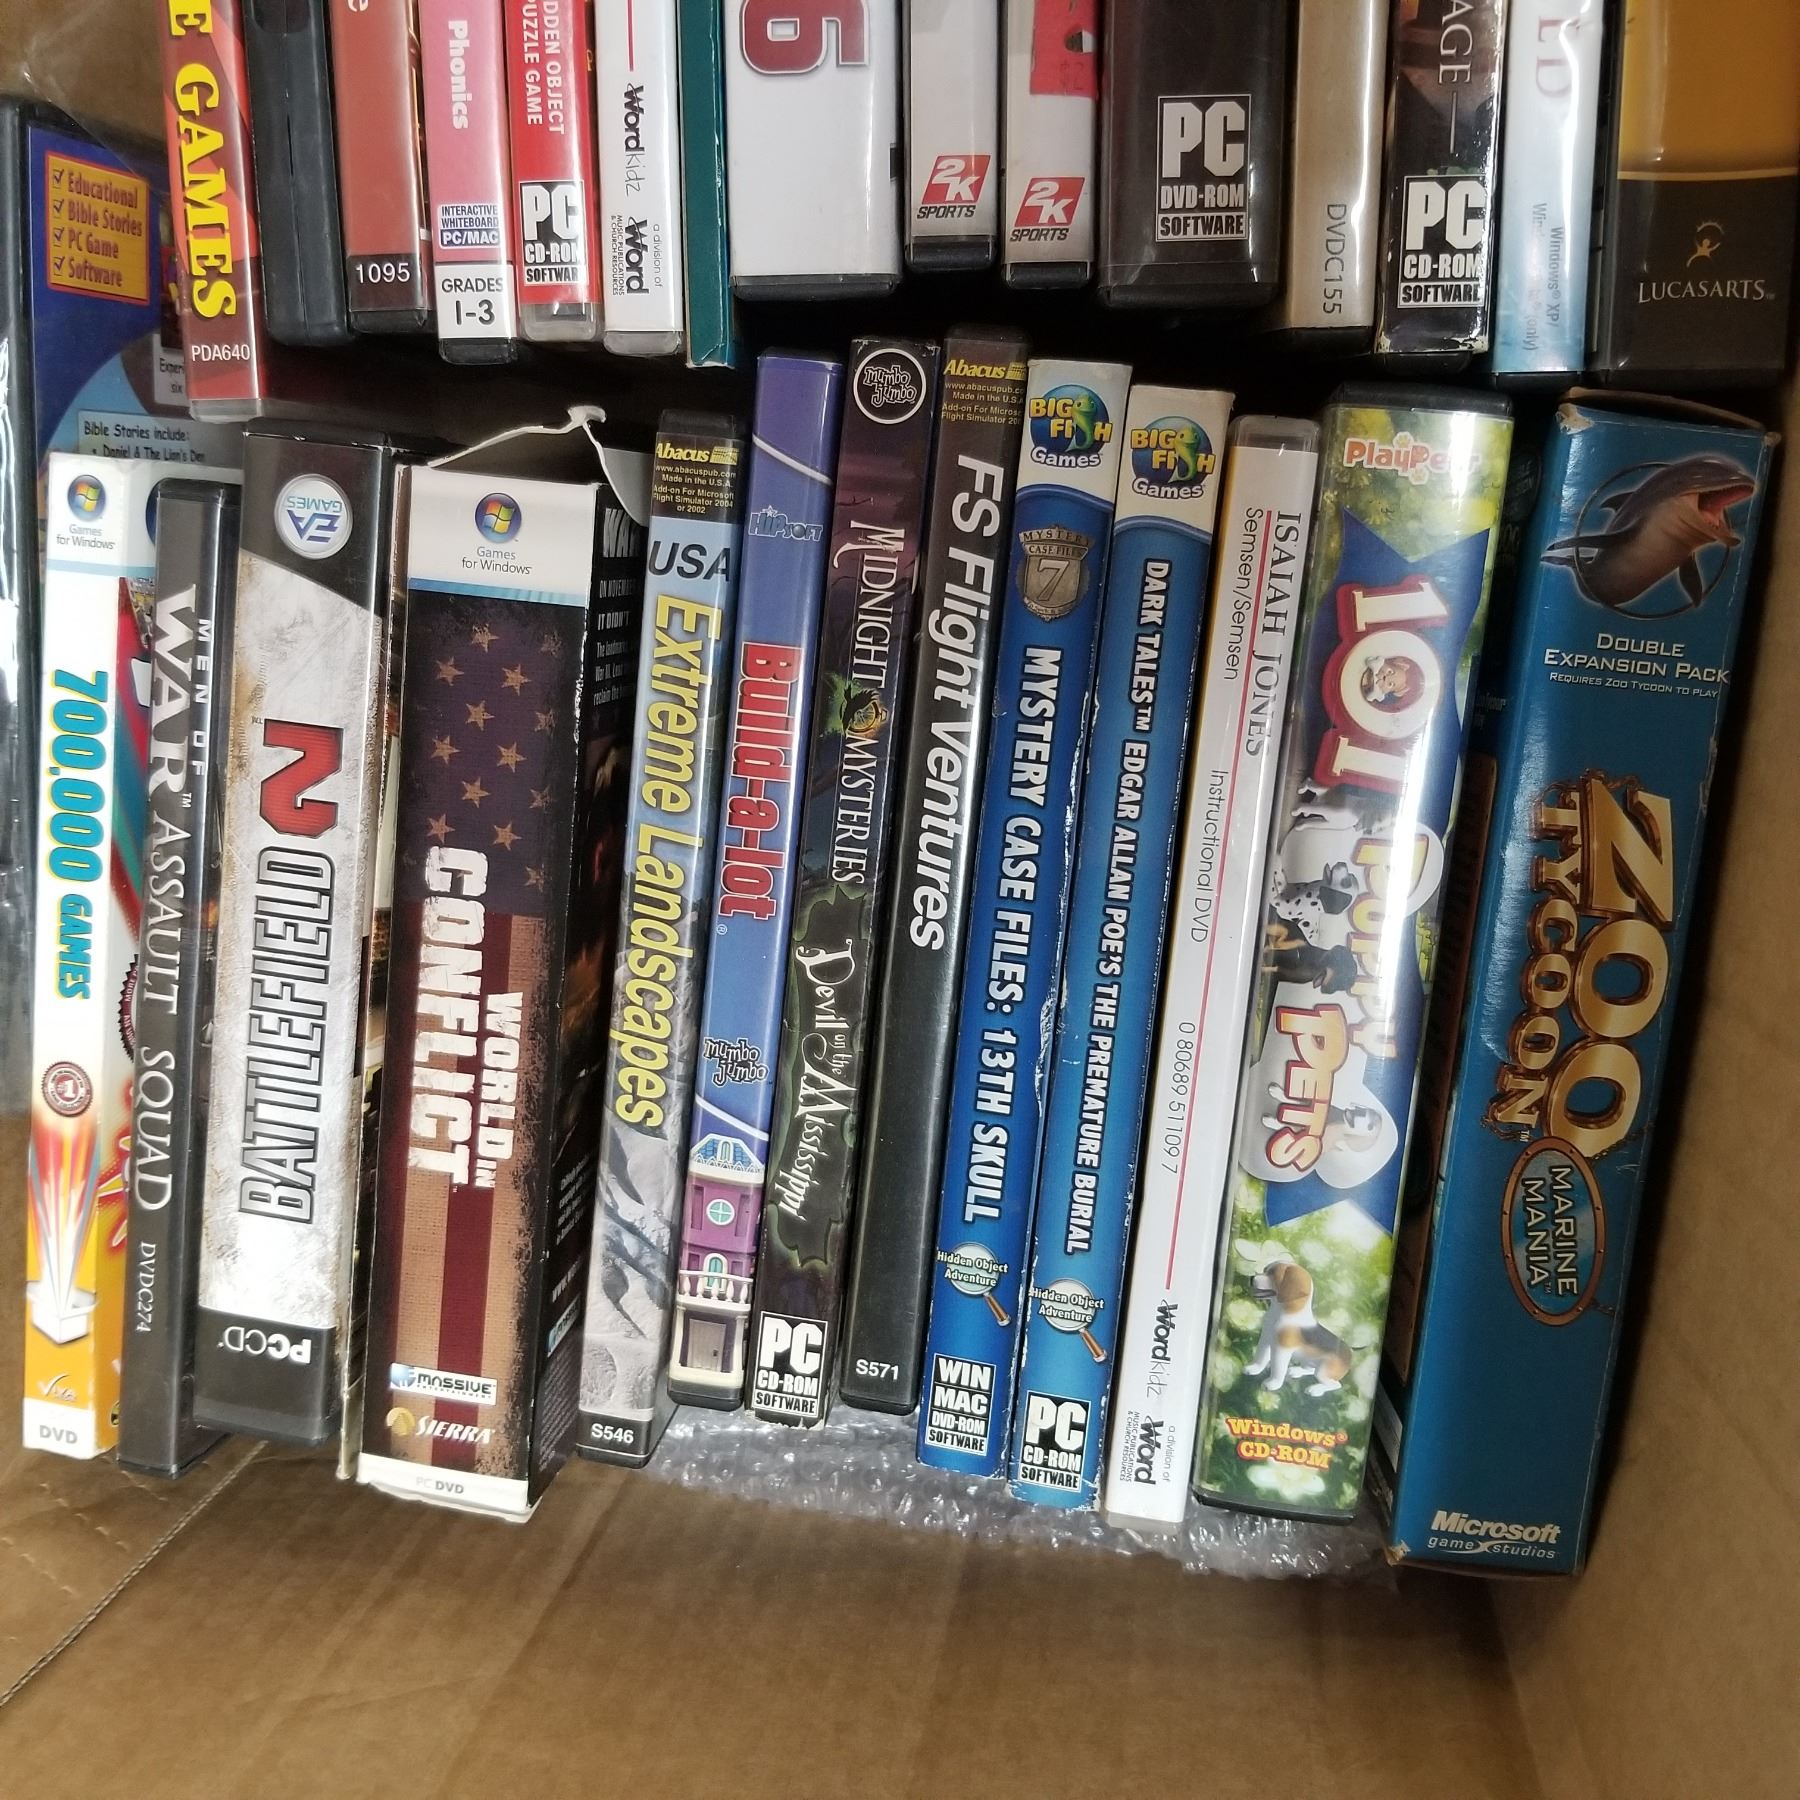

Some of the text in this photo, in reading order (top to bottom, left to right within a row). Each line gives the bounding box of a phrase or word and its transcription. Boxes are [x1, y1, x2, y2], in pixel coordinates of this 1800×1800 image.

[448, 20, 473, 130] Phonics
[525, 70, 543, 125] GAME
[546, 61, 565, 135] OBJECT
[624, 82, 647, 197] Wordkidz
[1162, 101, 1245, 178] PC
[68, 170, 138, 209] Educational
[173, 63, 237, 319] GAMES
[932, 159, 980, 201] 2K
[441, 204, 498, 216] INTERACTIVE
[1025, 182, 1074, 224] 2K
[1160, 184, 1244, 210] DVD-ROM
[68, 200, 142, 237] Bible Stories
[441, 217, 499, 229] WHITEBOARD
[521, 185, 578, 241] PC
[916, 205, 977, 220] SPORTS
[1160, 214, 1244, 236] SOFTWARE
[1405, 181, 1486, 250] PC
[68, 227, 118, 259] PC Game
[442, 231, 499, 245] PC/MAC
[1009, 228, 1069, 242] SPORTS
[617, 242, 625, 296] PUBLICATIONS
[624, 216, 650, 294] Word
[653, 235, 662, 274] division
[1322, 203, 1347, 315] DVDC155
[1403, 253, 1481, 279] CD-ROM
[68, 256, 122, 287] Software
[355, 262, 411, 284] 1095
[441, 278, 503, 293] GRADES
[1638, 279, 1766, 304] LUCASARTS
[191, 344, 251, 362] PDA640
[863, 366, 911, 387] mumbo
[943, 359, 1006, 379] Abacus
[871, 384, 917, 406] jumbo
[942, 402, 972, 412] Add-on
[952, 391, 975, 400] Made
[1030, 397, 1073, 419] BIG
[84, 421, 150, 439] Bible Stories
[941, 411, 1006, 424] Flight Simulator
[103, 444, 160, 460] Daniel The
[656, 443, 710, 462] Abacus
[1131, 429, 1177, 450] BIG
[1031, 447, 1101, 468] Games
[662, 474, 682, 483] Made
[1132, 477, 1203, 500] Games
[287, 496, 342, 513] GAMES
[675, 495, 713, 506] Simulator
[683, 488, 734, 500] For Microsoft
[687, 506, 706, 514] 2002
[69, 523, 103, 537] Games
[287, 509, 341, 543] EA
[56, 534, 115, 551] for Windows
[476, 545, 516, 560] Games
[1029, 545, 1054, 554] CASE
[461, 557, 532, 575] for Windows
[648, 540, 731, 582] USA
[1037, 559, 1070, 601] 7
[1223, 507, 1264, 681] Semsen/Semsen
[1244, 511, 1301, 757] ISAIAH JONES
[191, 619, 212, 776] MEN OF
[831, 520, 905, 884] MIDNIGHT MYSTERIES
[909, 454, 1004, 951] FS Flight Ventures
[1010, 648, 1062, 806] MYSTERY
[718, 643, 806, 920] Build-a-lot
[47, 669, 108, 1000] 700,000 GAMES
[609, 594, 723, 1127] Extreme Landscapes
[1000, 816, 1041, 901] CASE
[1066, 560, 1172, 1255] DARK EDGAR ALLAN POE'S THE PREMATURE BURIAL
[238, 718, 344, 1225] BATTLEFIELD 2
[984, 910, 1032, 1014] FILES:
[1161, 769, 1229, 1174] Instructional DVD 80689 51109 7
[1495, 789, 1582, 1131] TYCOON
[1548, 777, 1676, 1158] ZOO
[795, 938, 855, 1029] Devil
[408, 845, 489, 1186] CONFLICT
[703, 1038, 760, 1062] mumbo
[134, 811, 191, 1333] ASSAULT SQUAD DVDC274
[713, 1060, 769, 1085] jumbo
[979, 1030, 1016, 1113] 13TH
[474, 991, 524, 1188] WORLD IN
[1264, 1003, 1350, 1173] PETS
[774, 1032, 858, 1222] Mississippi
[965, 1122, 1008, 1223] SKULL
[1520, 1177, 1550, 1286] MANIA
[1551, 1164, 1578, 1296] MARINE
[937, 1250, 1009, 1273] Hidden Object
[944, 1268, 997, 1287] Adventure
[1031, 1287, 1105, 1309] Hidden Object
[1038, 1304, 1093, 1323] Adventure
[760, 1316, 822, 1375] PC
[1144, 1298, 1179, 1400] Wordkidz
[417, 1373, 492, 1395] MASSIVE
[757, 1369, 819, 1397] CD-ROM
[855, 1358, 900, 1381] S571
[938, 1357, 992, 1390] WIN
[755, 1391, 815, 1414] SOFTWARE
[934, 1386, 988, 1416] MAC
[39, 1425, 78, 1444] DVD
[416, 1415, 493, 1444] SIERRA
[591, 1422, 634, 1444] S546
[932, 1411, 986, 1436] DVD-ROM
[1026, 1394, 1087, 1451] PC
[928, 1428, 985, 1452] SOFTWARE
[1133, 1415, 1164, 1485] Word
[1238, 1440, 1331, 1470] CD-ROM
[1023, 1446, 1082, 1473] CD-ROM
[435, 1480, 465, 1494] DVD
[1021, 1465, 1080, 1489] SOFTWARE
[1430, 1510, 1562, 1544] Microsoft
[1427, 1535, 1556, 1560] game studios
